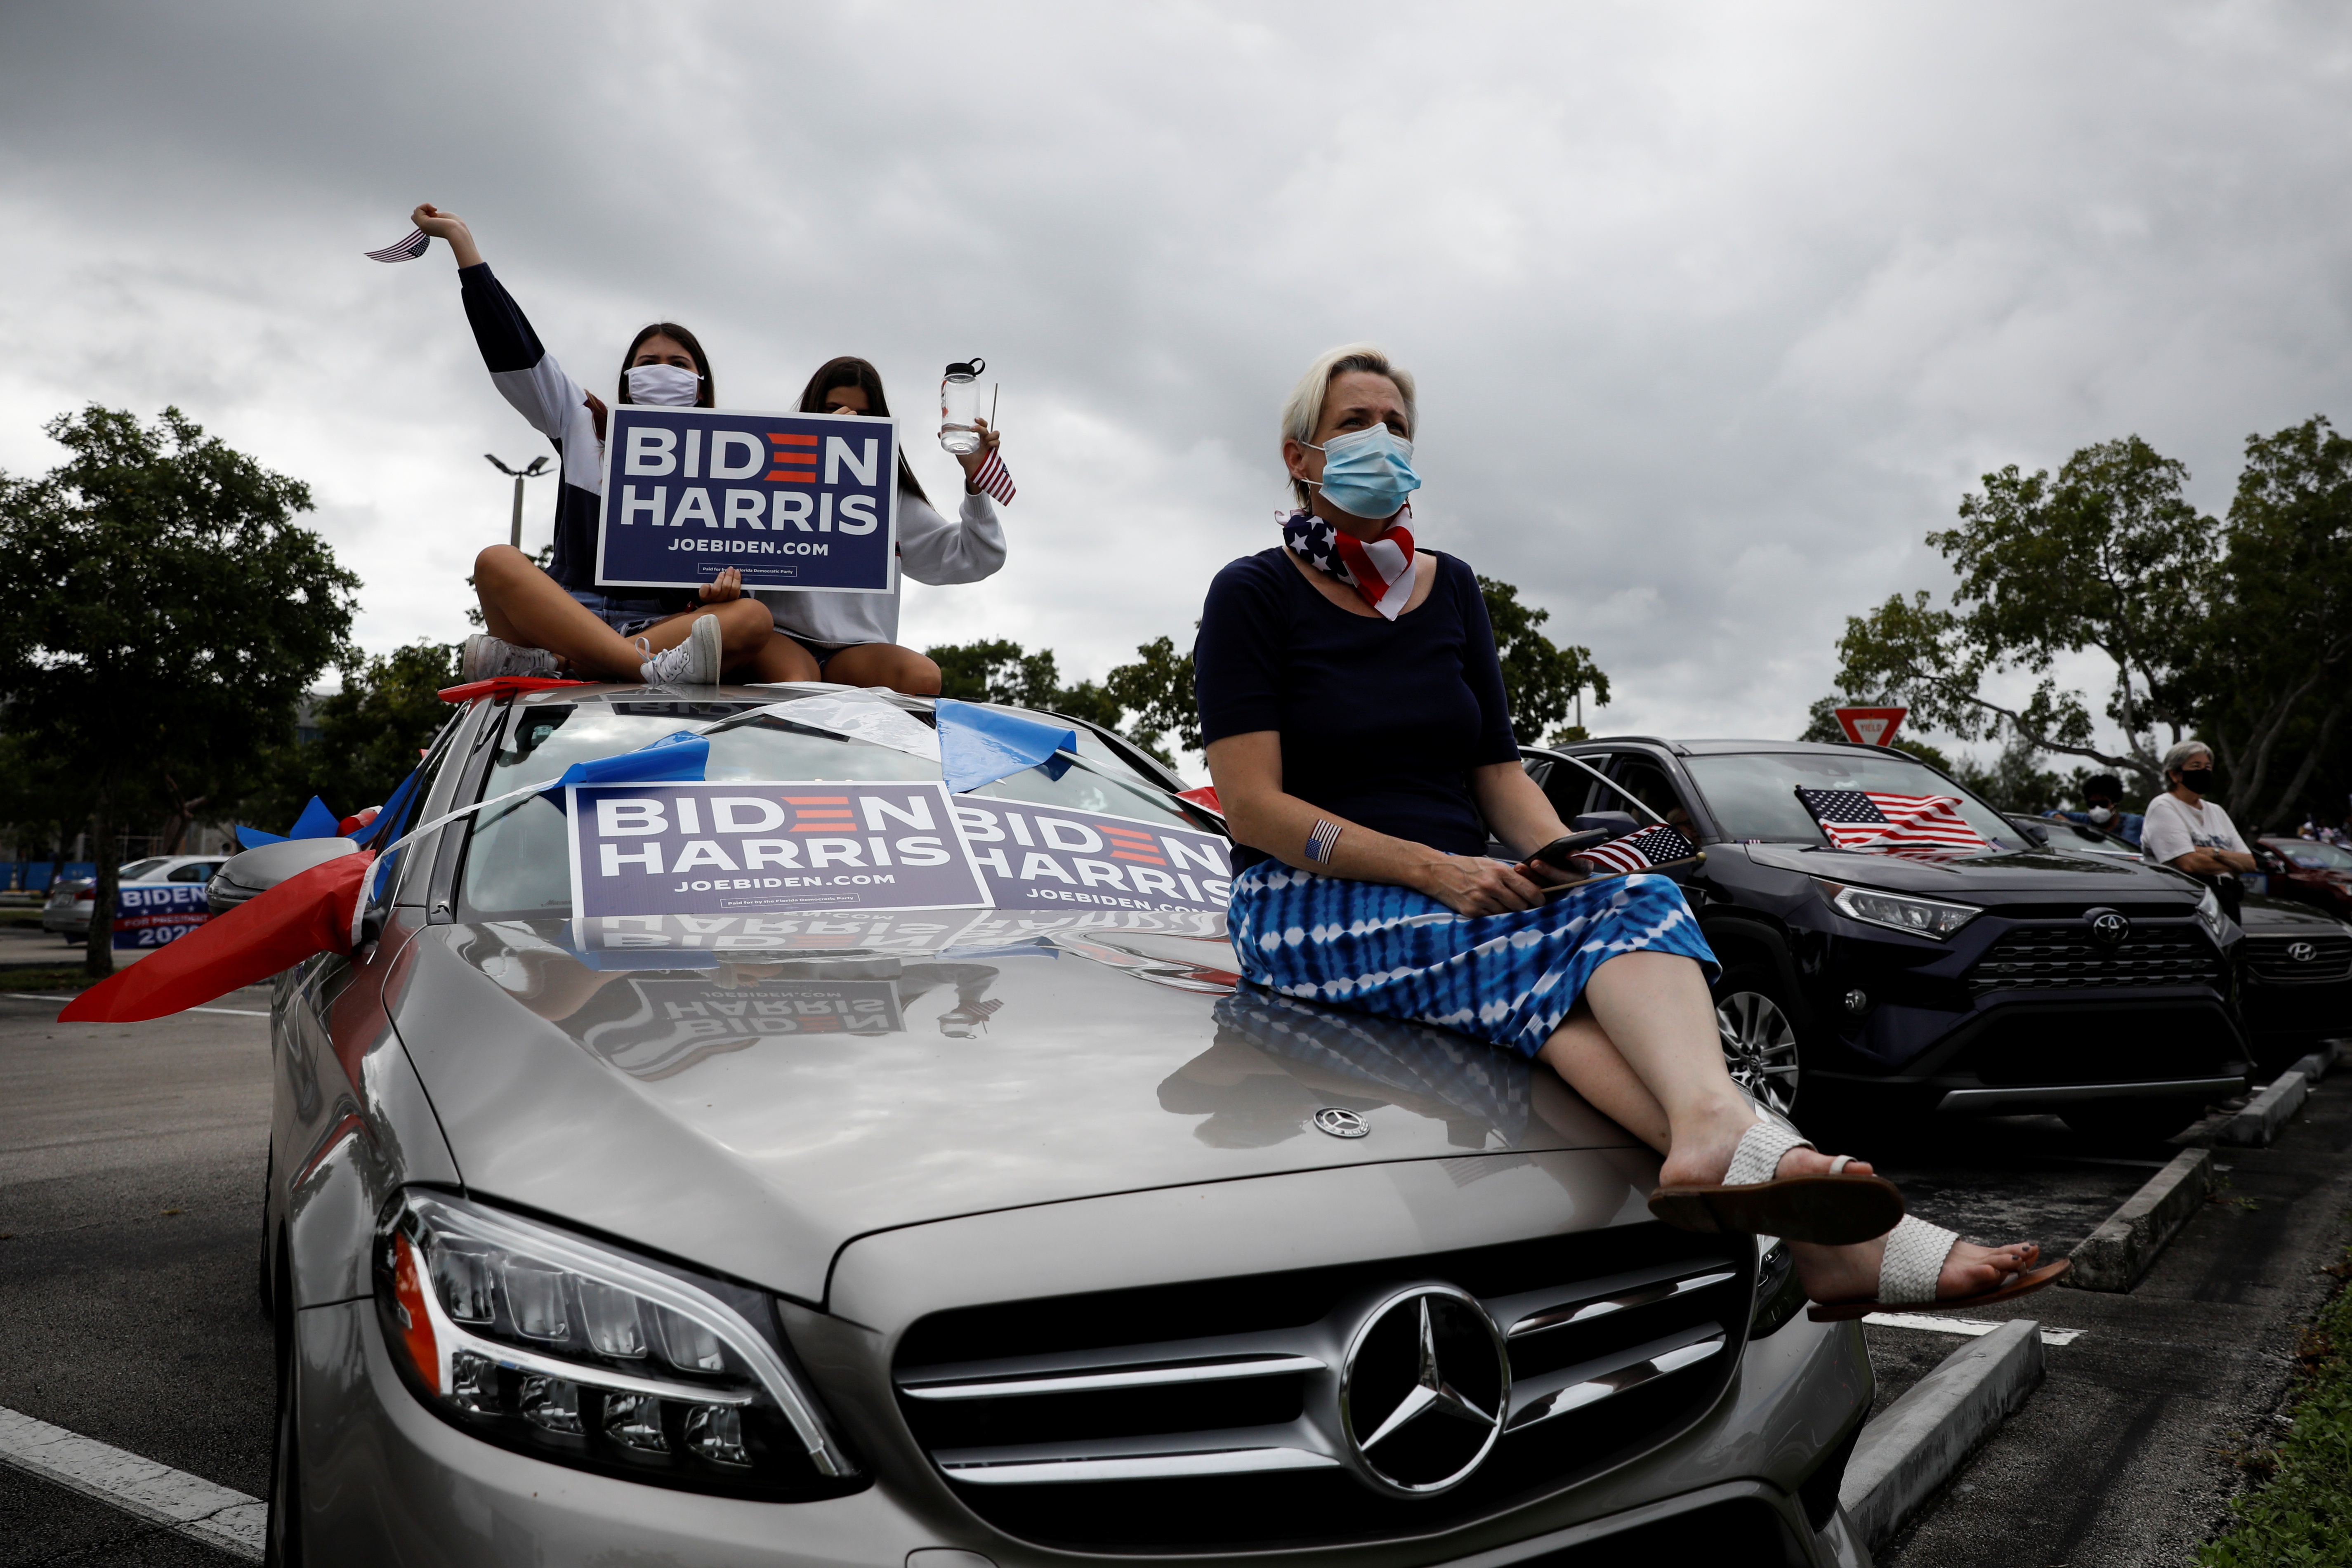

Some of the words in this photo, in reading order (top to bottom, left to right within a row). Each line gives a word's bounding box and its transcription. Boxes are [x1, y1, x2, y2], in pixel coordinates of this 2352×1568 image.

[625, 426, 878, 486] BIDEN
[620, 484, 878, 535] HARRIS
[668, 538, 829, 556] JOEBIDEN.COM
[1860, 724, 1883, 732] YIELD
[596, 796, 936, 837] BIDEN
[600, 836, 951, 877] HARRIS
[957, 806, 1232, 878] BIDEN
[122, 887, 207, 907] BIDEN
[674, 873, 895, 892] JOEBIDEN.COM
[976, 848, 1231, 907] HARRIS
[123, 918, 149, 928] FOR
[152, 914, 209, 924] PRESIDENT
